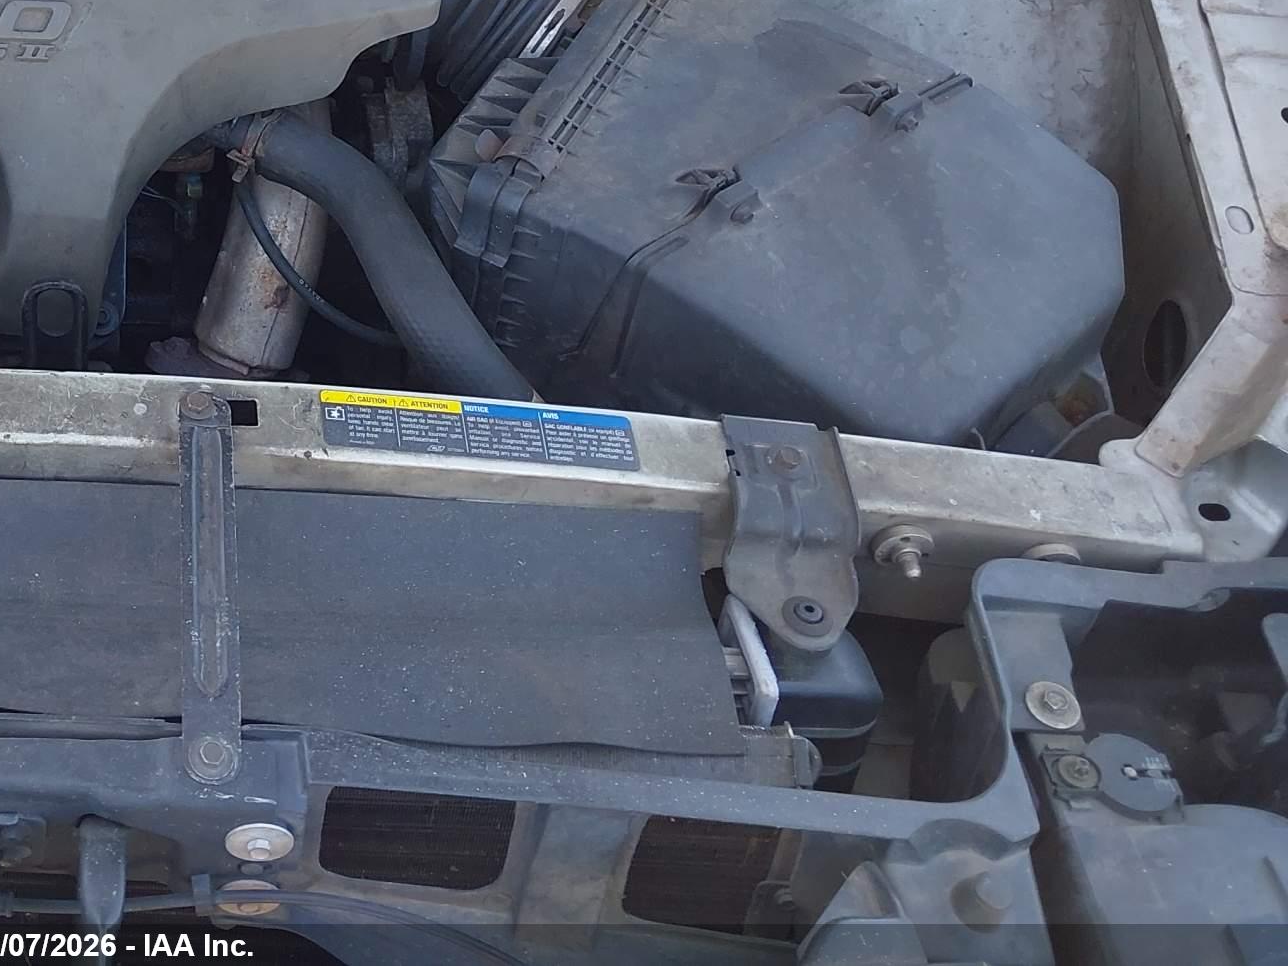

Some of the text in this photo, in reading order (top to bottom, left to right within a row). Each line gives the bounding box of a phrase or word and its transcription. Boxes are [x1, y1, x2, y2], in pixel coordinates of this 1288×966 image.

[357, 396, 387, 404] CAUTION
[411, 401, 448, 409] ATTENTION
[464, 405, 489, 413] NOTICE
